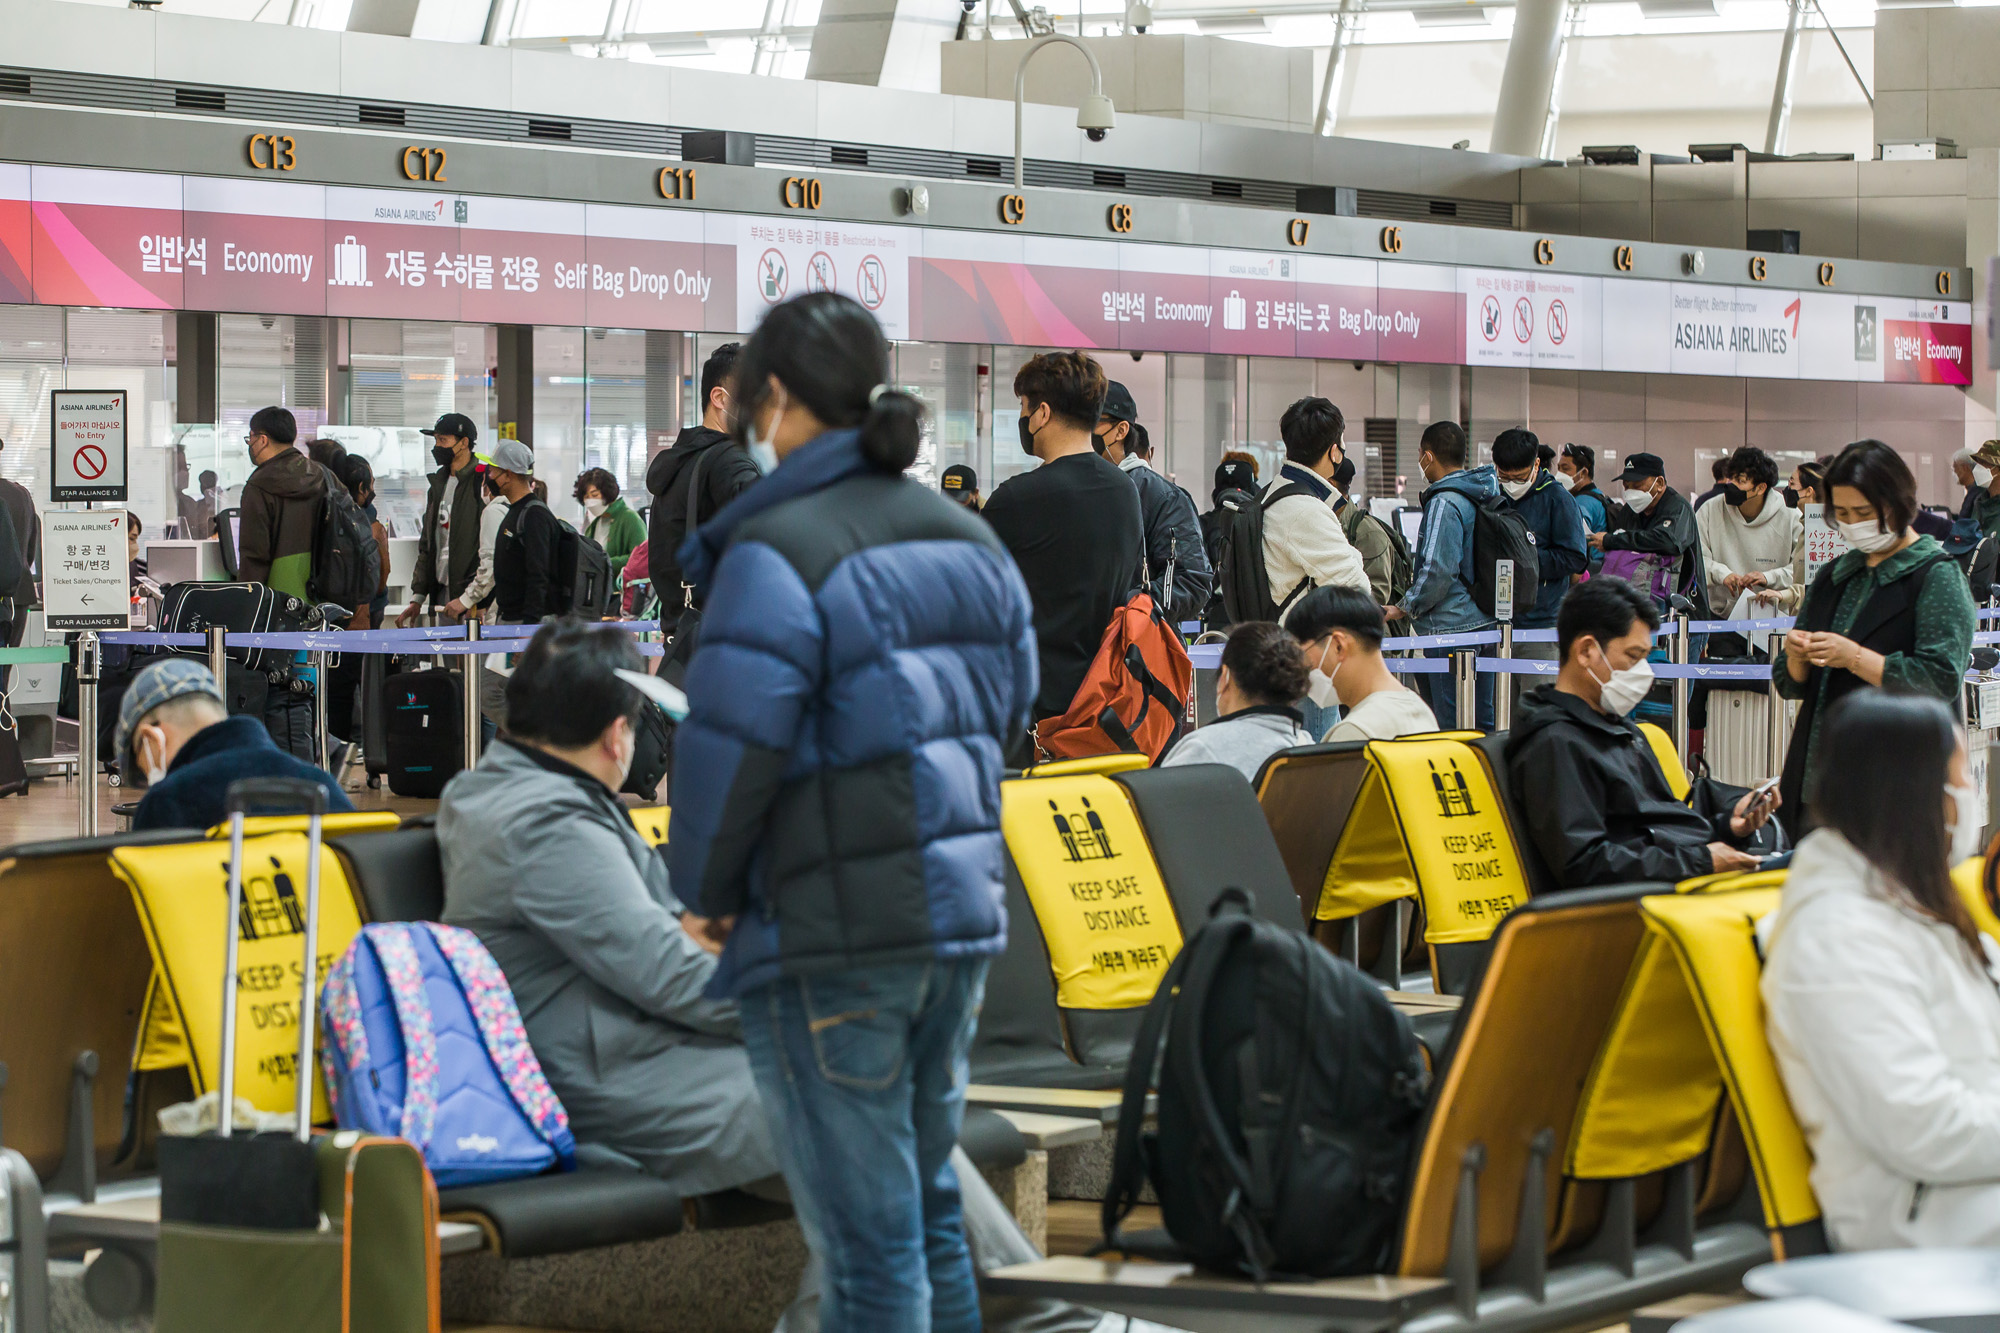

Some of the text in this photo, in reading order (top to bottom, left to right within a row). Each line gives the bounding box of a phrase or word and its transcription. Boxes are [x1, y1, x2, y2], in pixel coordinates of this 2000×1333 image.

[248, 133, 297, 171] C13
[402, 145, 447, 182] C12
[658, 166, 697, 200] C11
[784, 177, 822, 210] C10
[374, 207, 436, 222] ASIANA AIRLINES
[1002, 194, 1026, 225] C9
[1111, 203, 1133, 233] C8
[750, 226, 896, 248] 부치는 짐 탁송 금지 물품 Restricted Items
[1290, 218, 1311, 247] C7
[1384, 226, 1402, 253] C6
[139, 235, 313, 283] 일반석 Economy
[1537, 239, 1555, 265] C5
[1616, 245, 1633, 271] C4
[385, 249, 712, 303] 자동 수하물 전용 Self Bag Drop Only
[1751, 256, 1767, 281] C3
[1820, 262, 1835, 286] C2
[1938, 271, 1951, 294] C1
[1102, 290, 1213, 328] 일반석 Economy
[1674, 294, 1693, 309] Better
[1711, 297, 1729, 311] Better
[1729, 301, 1757, 313] tomorrow
[1255, 300, 1420, 339] 짐 부치는 곳 Bag Drop Only
[1674, 323, 1787, 354] ASIANA AIRLINES
[1894, 336, 1962, 364] 일반석 Economy
[60, 421, 120, 430] 들어가지 마십시오
[87, 432, 106, 440] Entry
[66, 545, 106, 556] 항 공 권
[63, 560, 110, 571] 구매/변경
[73, 577, 121, 585] Sales/Changes
[1441, 832, 1497, 854] KEEP SAFE
[1453, 859, 1503, 881] DISTANCE
[1068, 876, 1142, 902] KEEP SAFE
[1083, 905, 1150, 931] DISTANCE
[237, 964, 283, 991] KEEP
